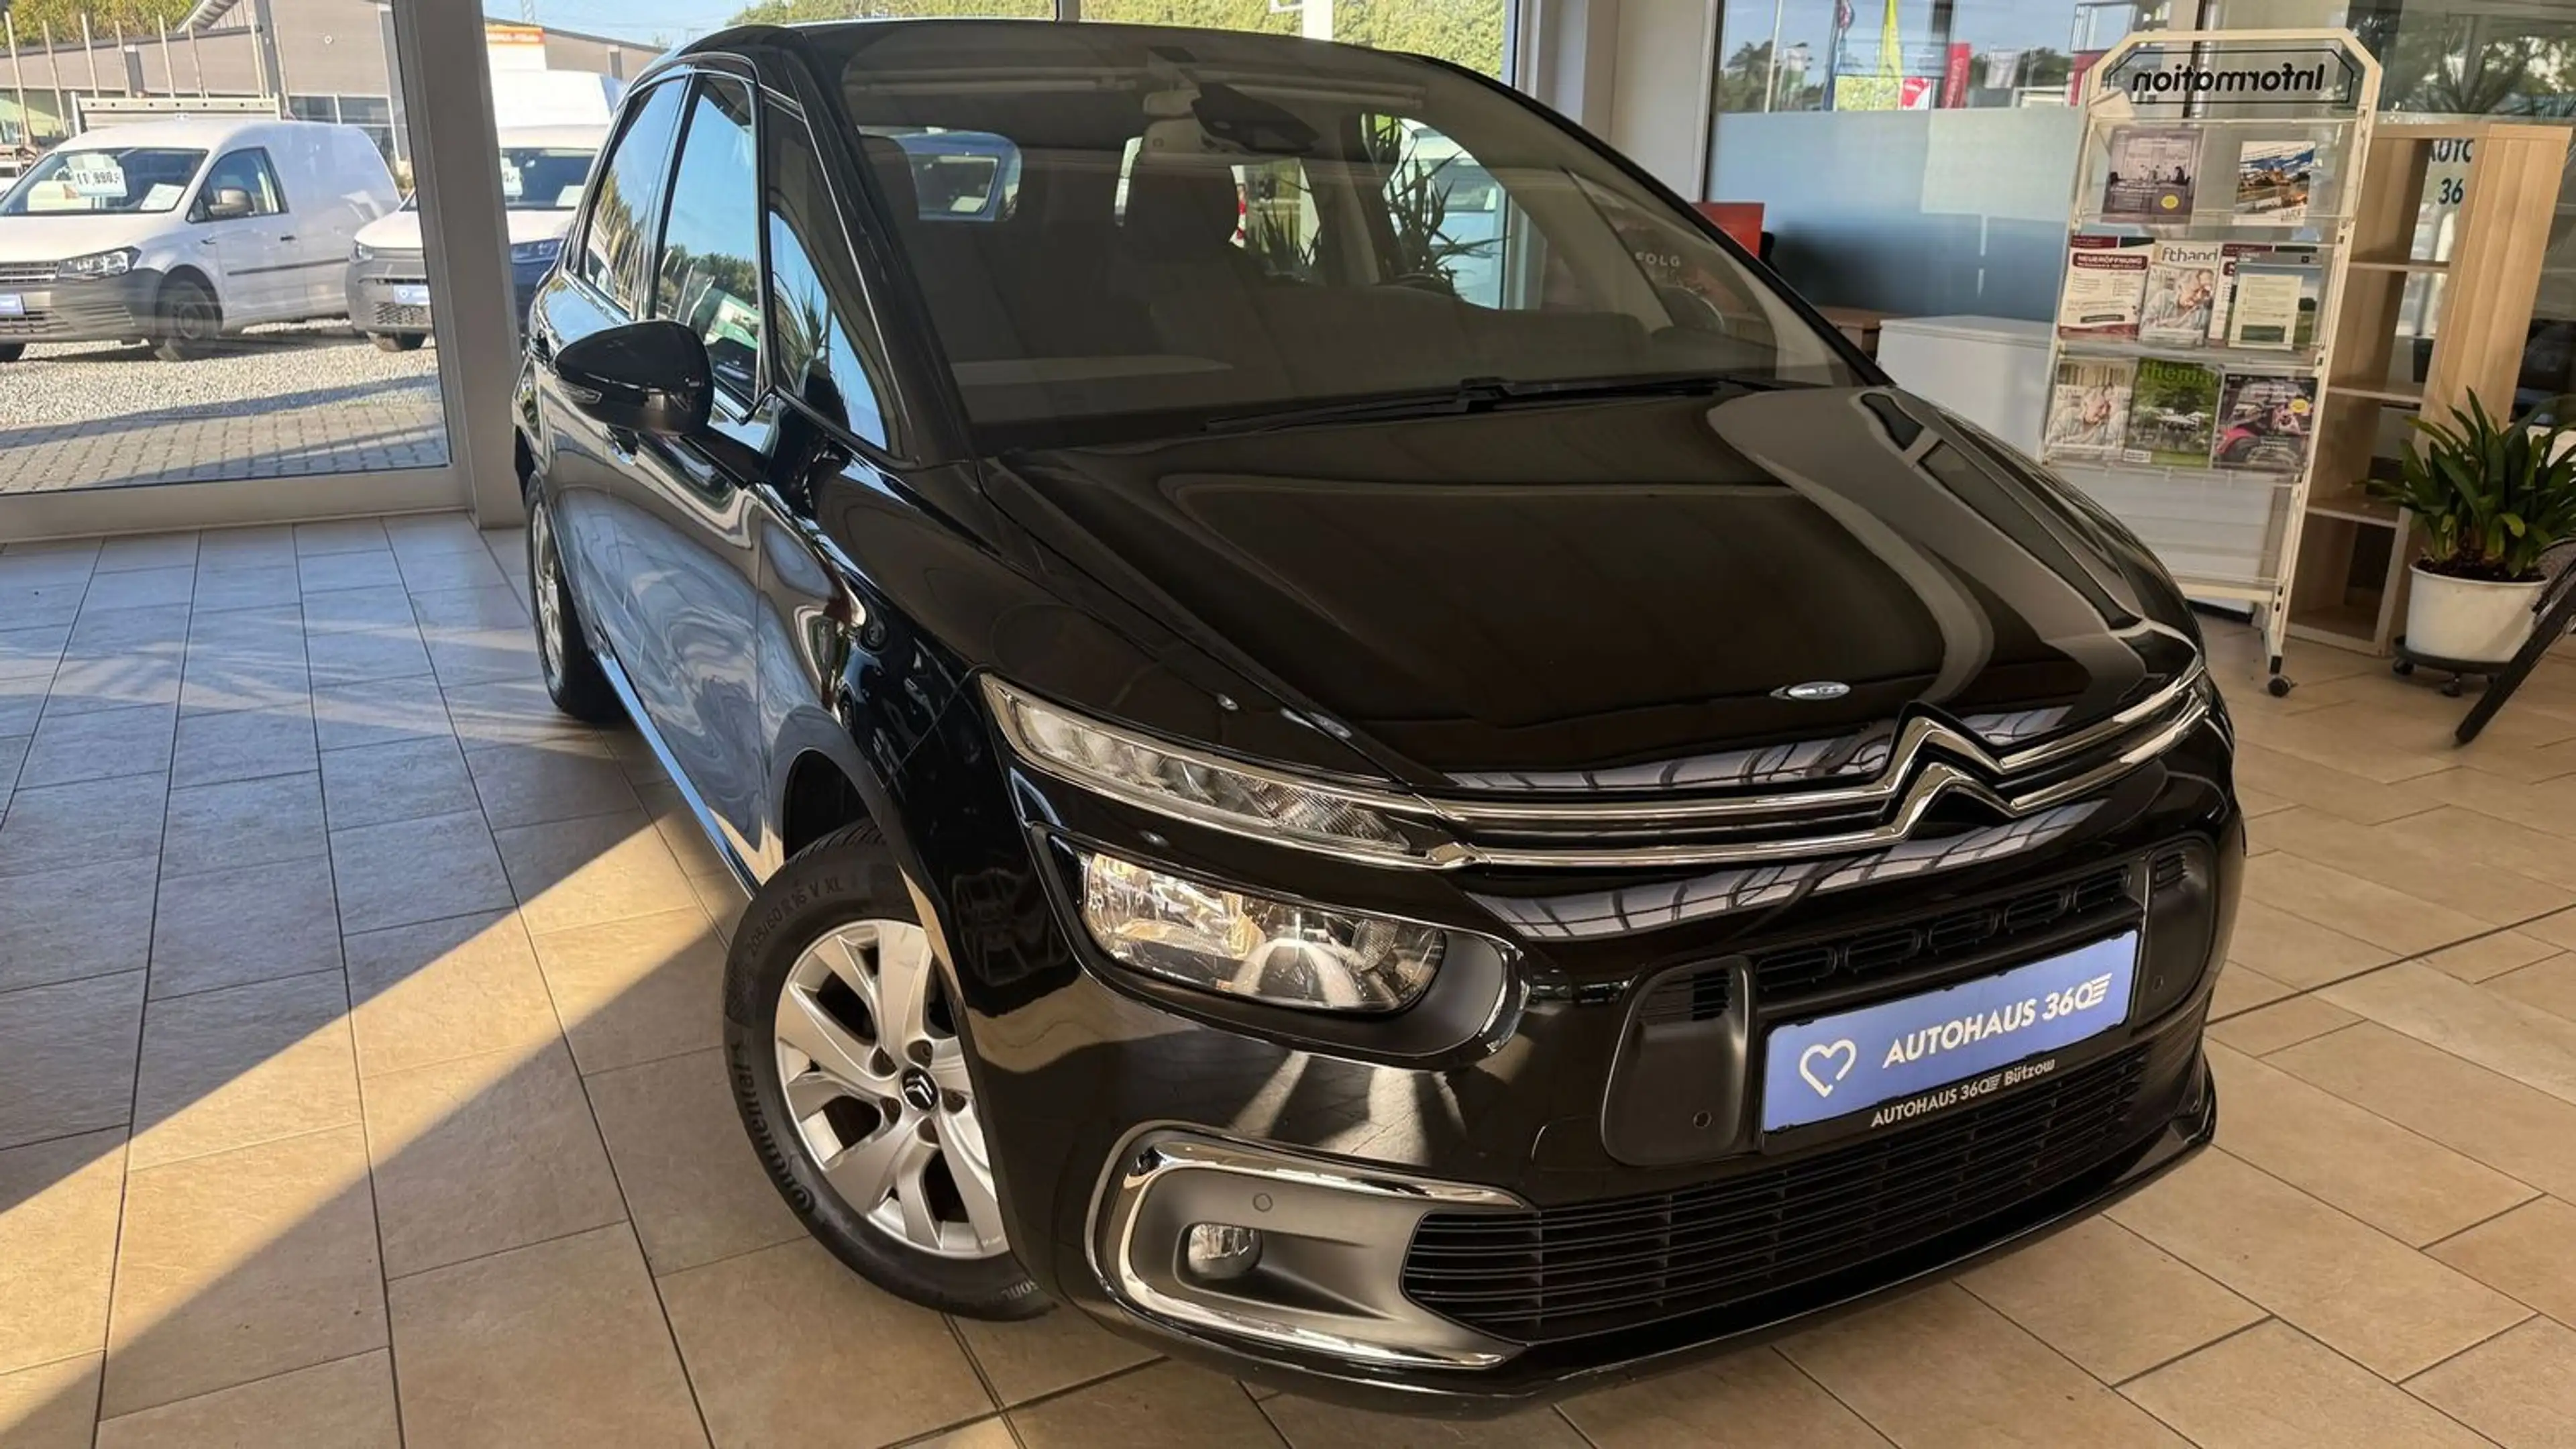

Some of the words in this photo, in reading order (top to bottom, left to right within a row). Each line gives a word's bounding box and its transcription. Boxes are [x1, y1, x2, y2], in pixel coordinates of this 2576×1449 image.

[1882, 998, 2037, 1069] AUTOHAUS
[1870, 1087, 1958, 1128] AUTOHAUS
[2003, 1058, 2055, 1087] Bützow
